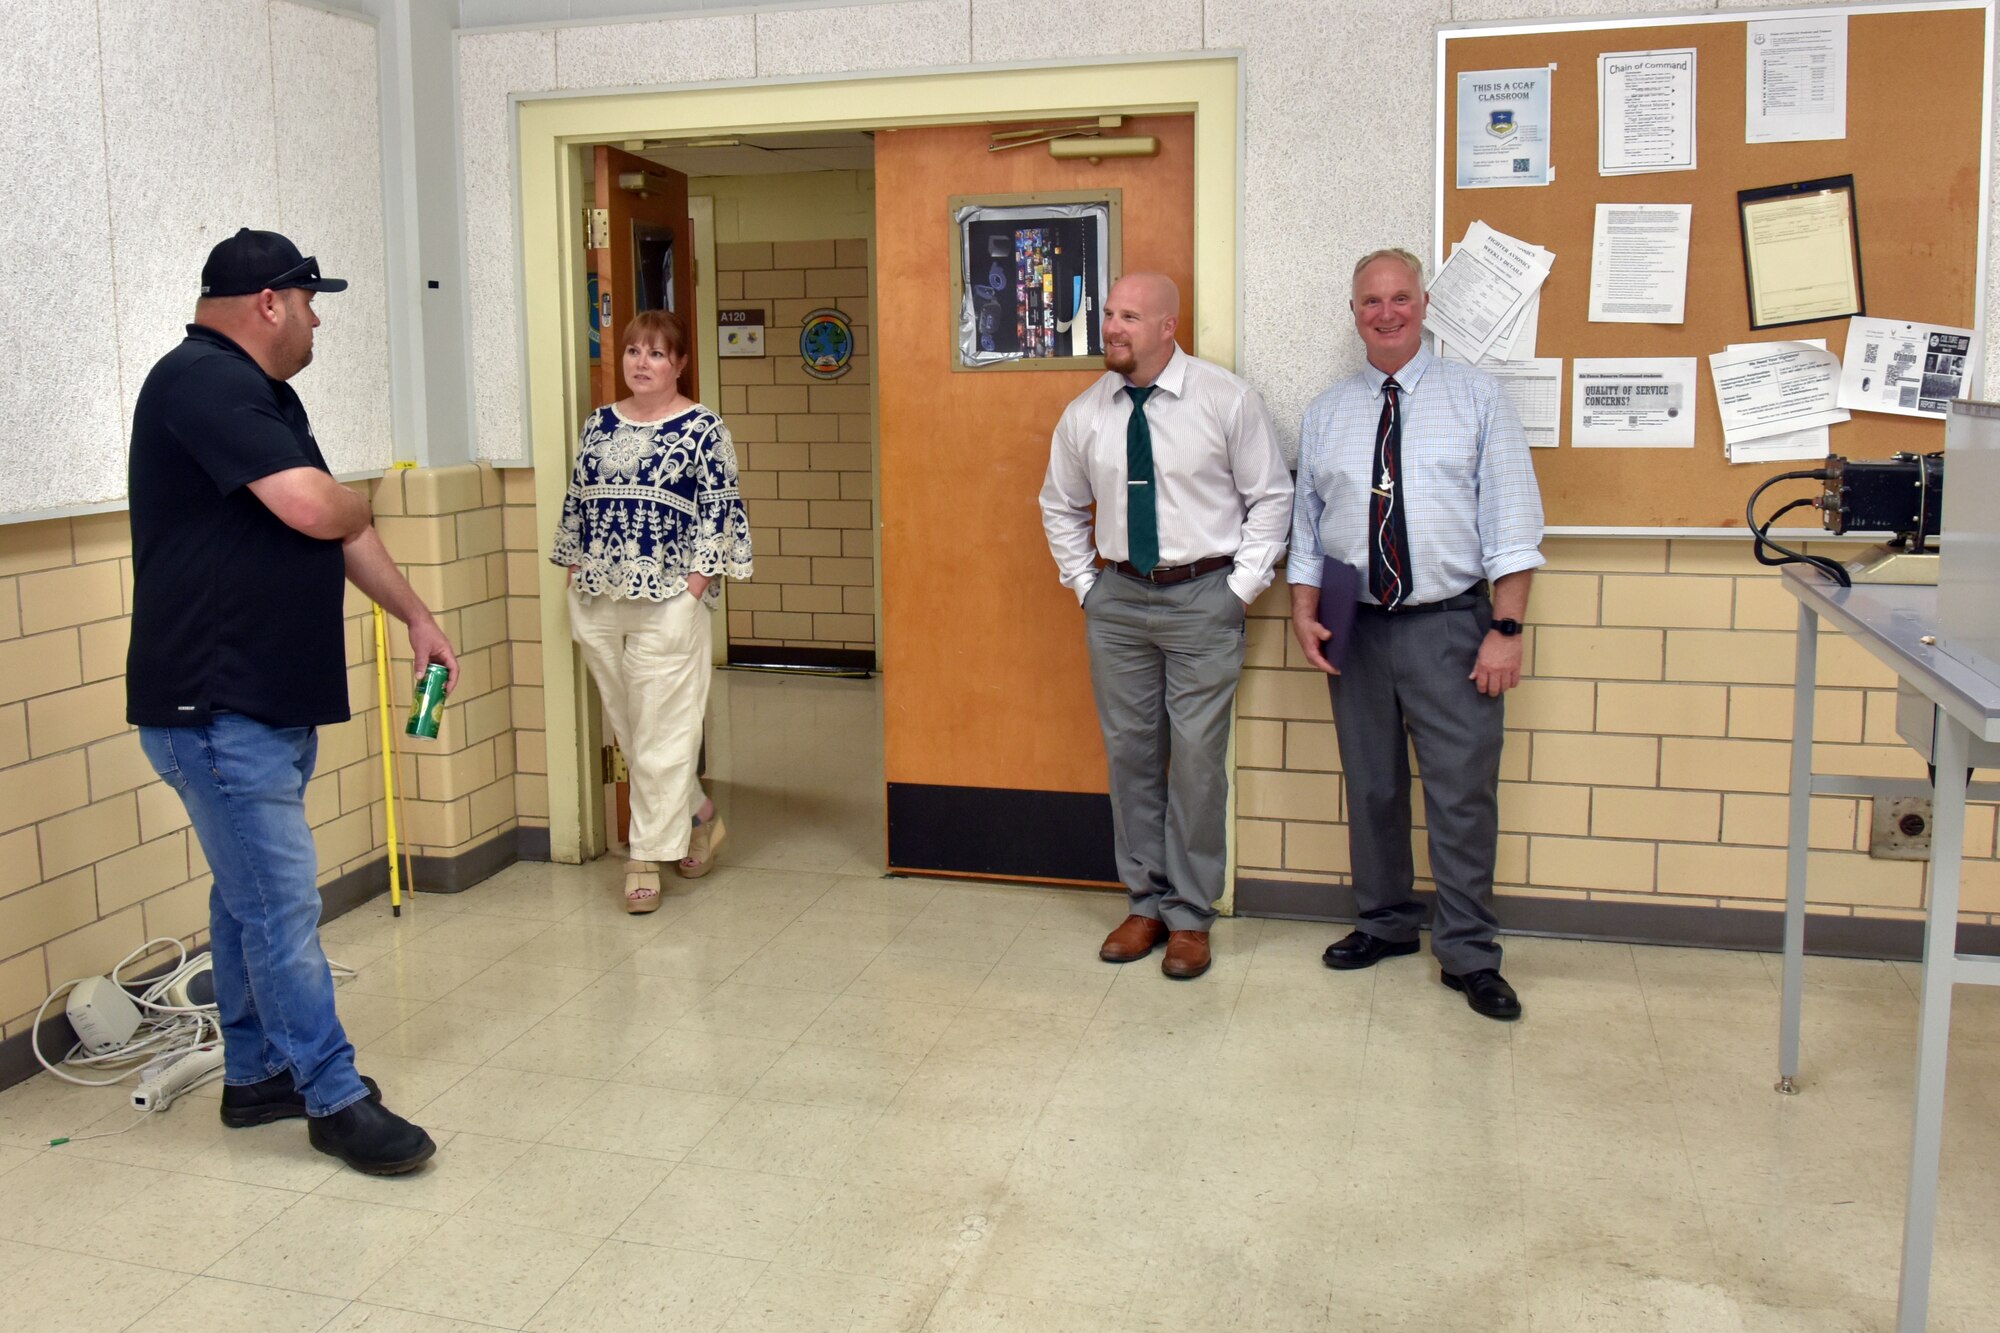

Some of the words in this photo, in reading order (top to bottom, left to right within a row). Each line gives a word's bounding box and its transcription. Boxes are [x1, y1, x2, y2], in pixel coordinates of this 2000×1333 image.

[1609, 63, 1633, 74] Chain
[1634, 62, 1644, 70] of
[1644, 60, 1688, 71] Command
[1472, 83, 1492, 92] THIS
[1493, 82, 1502, 91] IS
[1503, 82, 1510, 90] A
[1512, 81, 1536, 90] CCAF
[1478, 92, 1530, 102] CLASSROOM
[1487, 235, 1509, 255] FIGHTER
[1508, 250, 1532, 270] AVIONICS
[1482, 244, 1504, 262] WEEKLY
[1502, 259, 1524, 276] DETAILS
[720, 312, 746, 322] A120
[1585, 385, 1619, 396] QUALITY
[1622, 385, 1633, 395] OF
[1635, 385, 1669, 395] SERVICE
[1585, 396, 1631, 406] CONCERNS?
